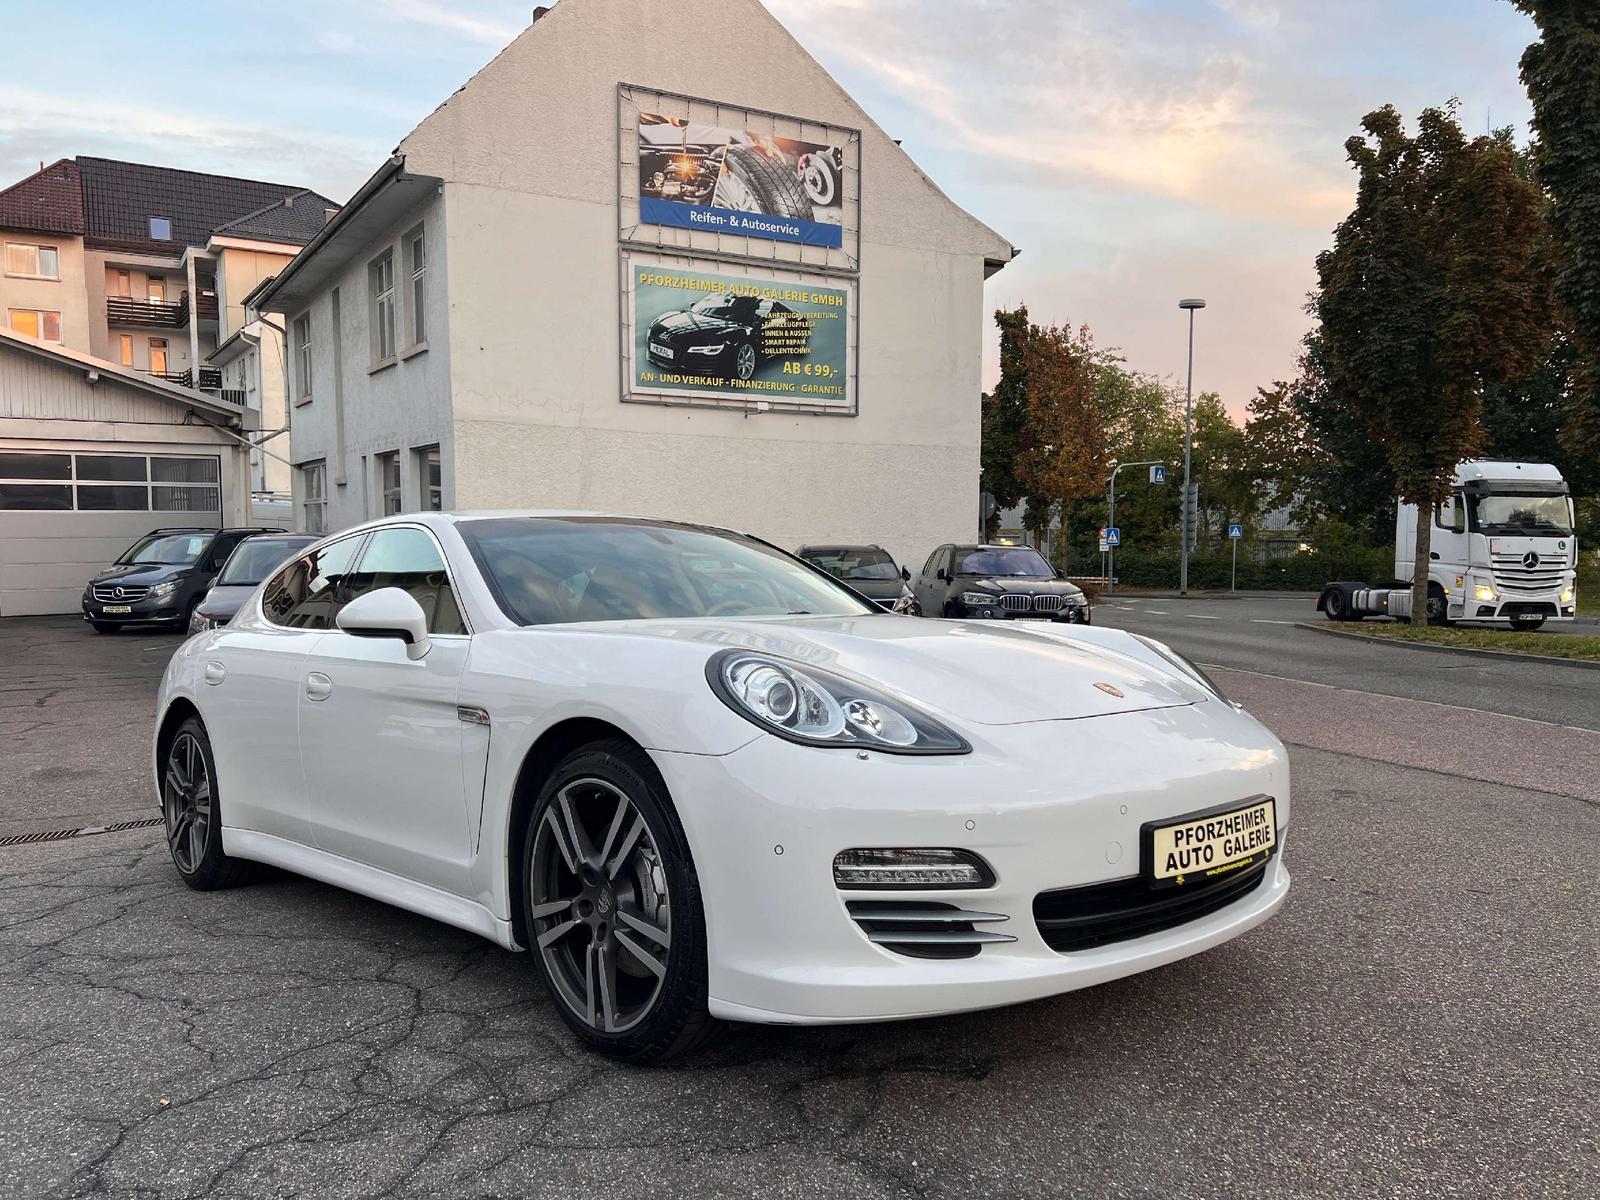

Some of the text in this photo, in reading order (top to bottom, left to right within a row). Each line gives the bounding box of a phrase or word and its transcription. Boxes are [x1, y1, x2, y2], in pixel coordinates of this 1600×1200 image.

[690, 211, 800, 236] Reifen- & Autoservice
[640, 274, 843, 306] PFORZHEIMER AUTO GALERIE GMBH
[641, 373, 658, 382] AN-
[660, 374, 681, 383] UND
[682, 376, 724, 386] VERKAUF
[731, 379, 795, 391] FINANZIERUNG
[801, 384, 843, 394] GARANTIE
[783, 362, 838, 378] AB € 99,-
[1174, 808, 1266, 848] PFORZHEIMER
[1165, 844, 1214, 872] AUTO
[1223, 825, 1271, 858] GALERIE
